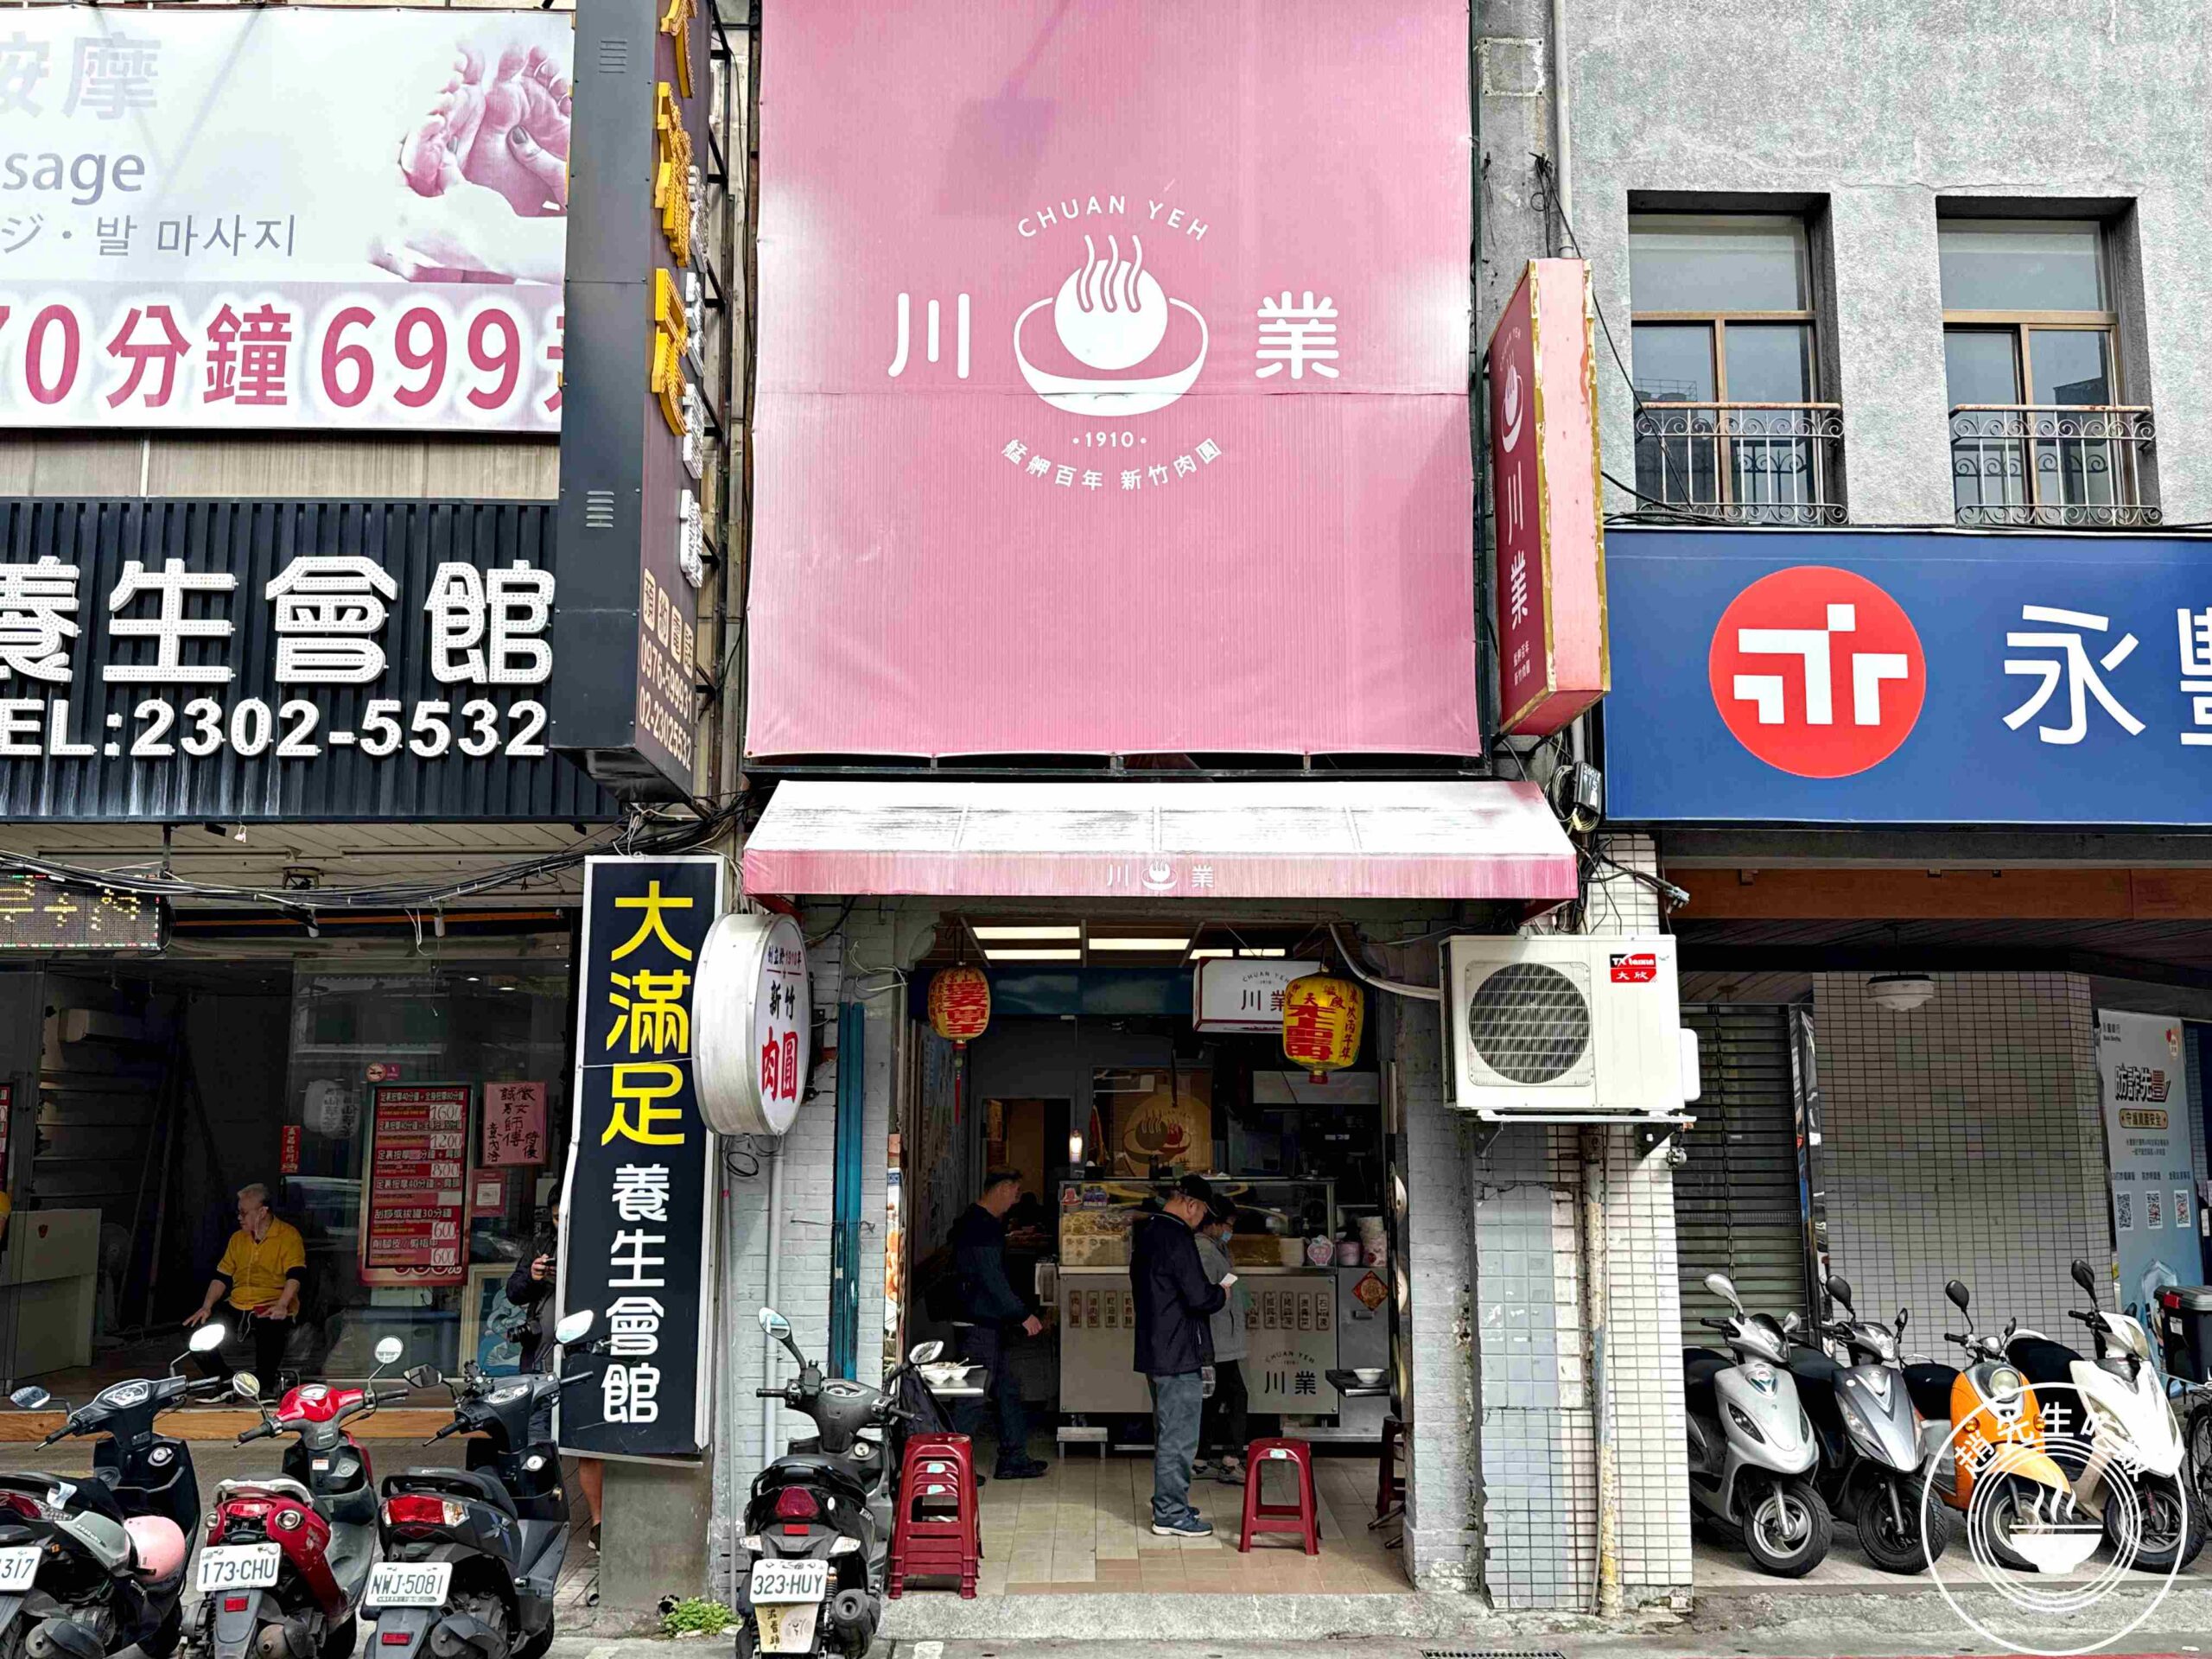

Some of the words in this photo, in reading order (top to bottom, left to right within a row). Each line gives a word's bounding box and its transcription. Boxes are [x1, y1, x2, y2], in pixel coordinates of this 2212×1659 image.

[2, 151, 145, 206] sage
[97, 215, 137, 256] 발
[157, 214, 295, 257] 마사지
[1018, 195, 1124, 238] CHUAN
[1147, 200, 1209, 240] YEH
[0, 302, 292, 409] 0分鐘
[321, 305, 563, 414] 699
[887, 292, 970, 378] 川
[1255, 290, 1339, 379] 業
[1001, 438, 1103, 490] 艋舺百年
[1121, 436, 1223, 491] 新竹肉圓
[1084, 432, 1134, 448] 1910
[639, 632, 693, 724] 0976-599931
[2002, 605, 2212, 746] 永
[639, 685, 691, 772] 02-23025532
[1106, 864, 1129, 887] 川
[601, 880, 693, 1146] 大滿足
[769, 980, 796, 1020] 新竹
[761, 1026, 798, 1103] 肉圓
[601, 1163, 670, 1423] 養生會館
[1264, 1370, 1317, 1395] 川業
